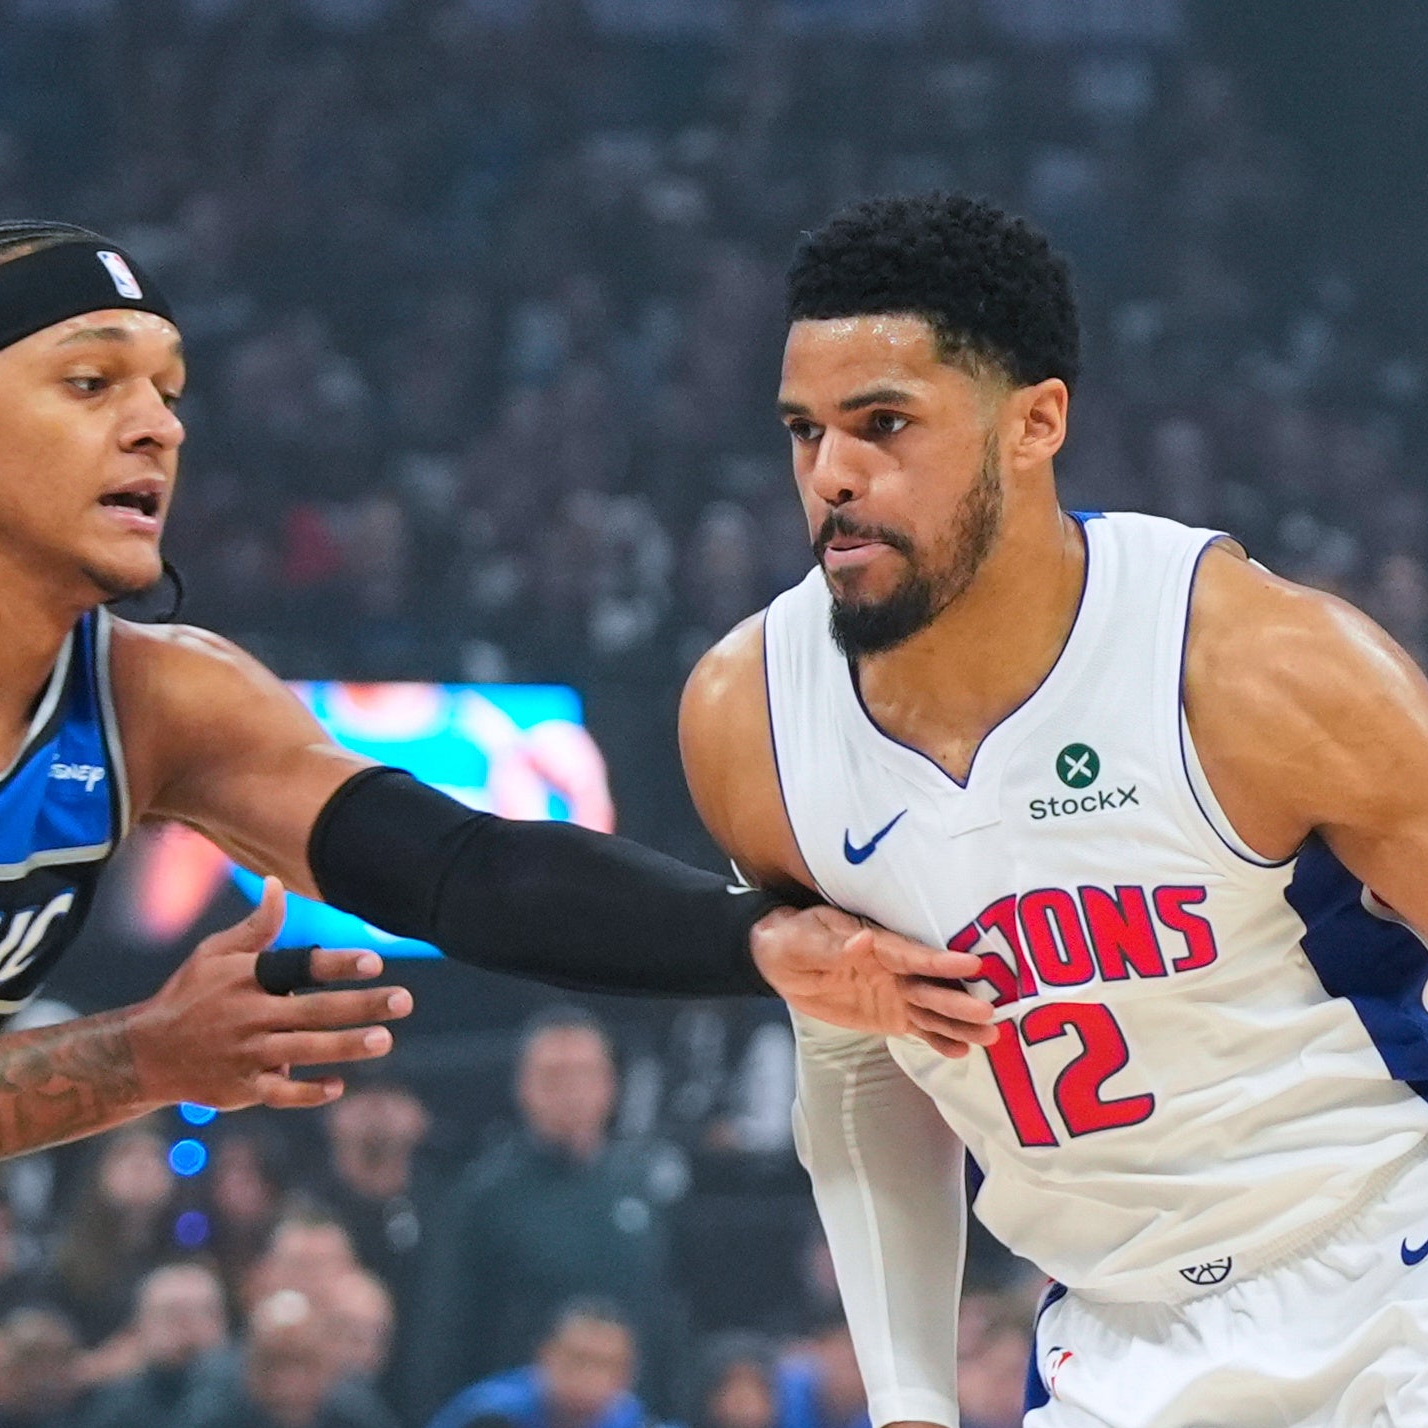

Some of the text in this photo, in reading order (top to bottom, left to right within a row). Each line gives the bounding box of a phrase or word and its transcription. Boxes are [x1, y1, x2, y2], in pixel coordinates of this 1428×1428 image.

[1029, 784, 1140, 820] StockX
[947, 885, 1219, 1009] STONS
[983, 1001, 1156, 1148] 12
